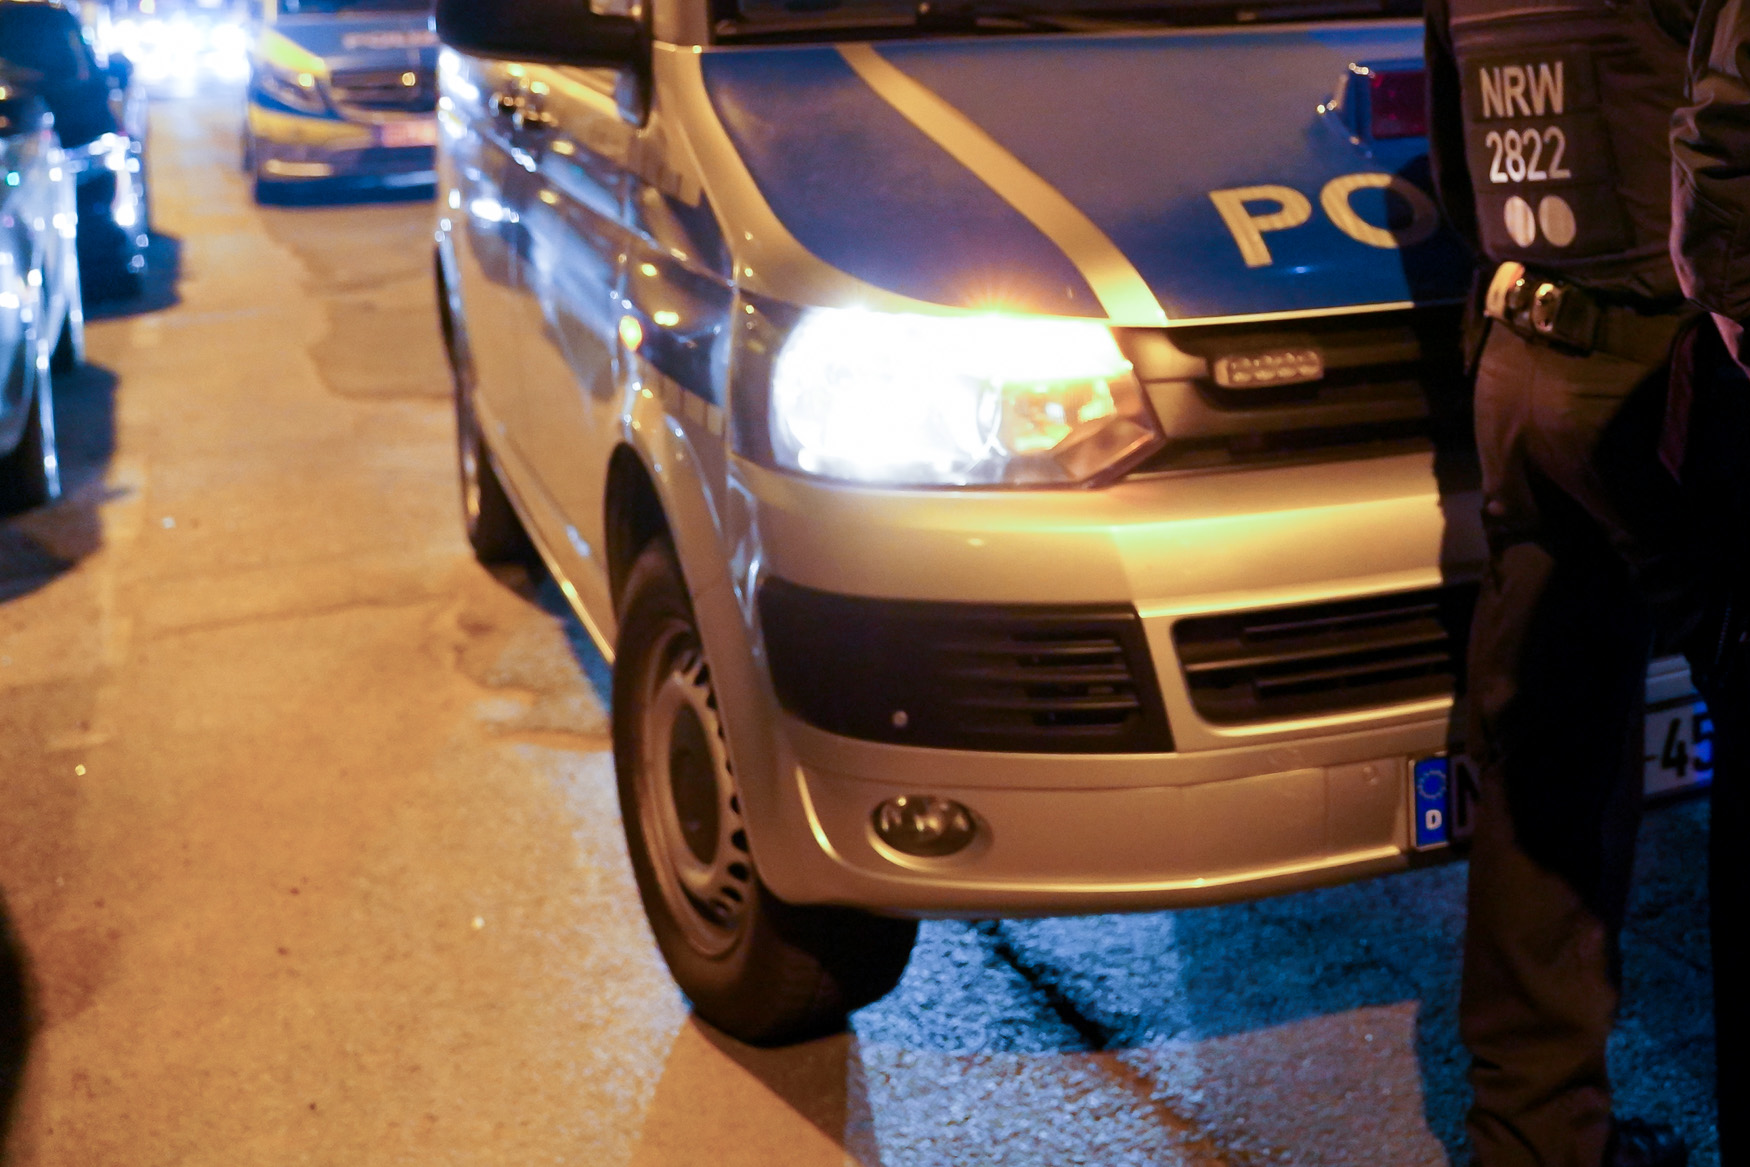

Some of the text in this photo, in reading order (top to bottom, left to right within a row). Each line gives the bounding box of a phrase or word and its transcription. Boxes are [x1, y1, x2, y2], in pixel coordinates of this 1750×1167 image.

[1479, 59, 1564, 119] NRW
[1484, 126, 1572, 185] 2822
[1208, 172, 1440, 270] PO
[1425, 808, 1443, 831] D
